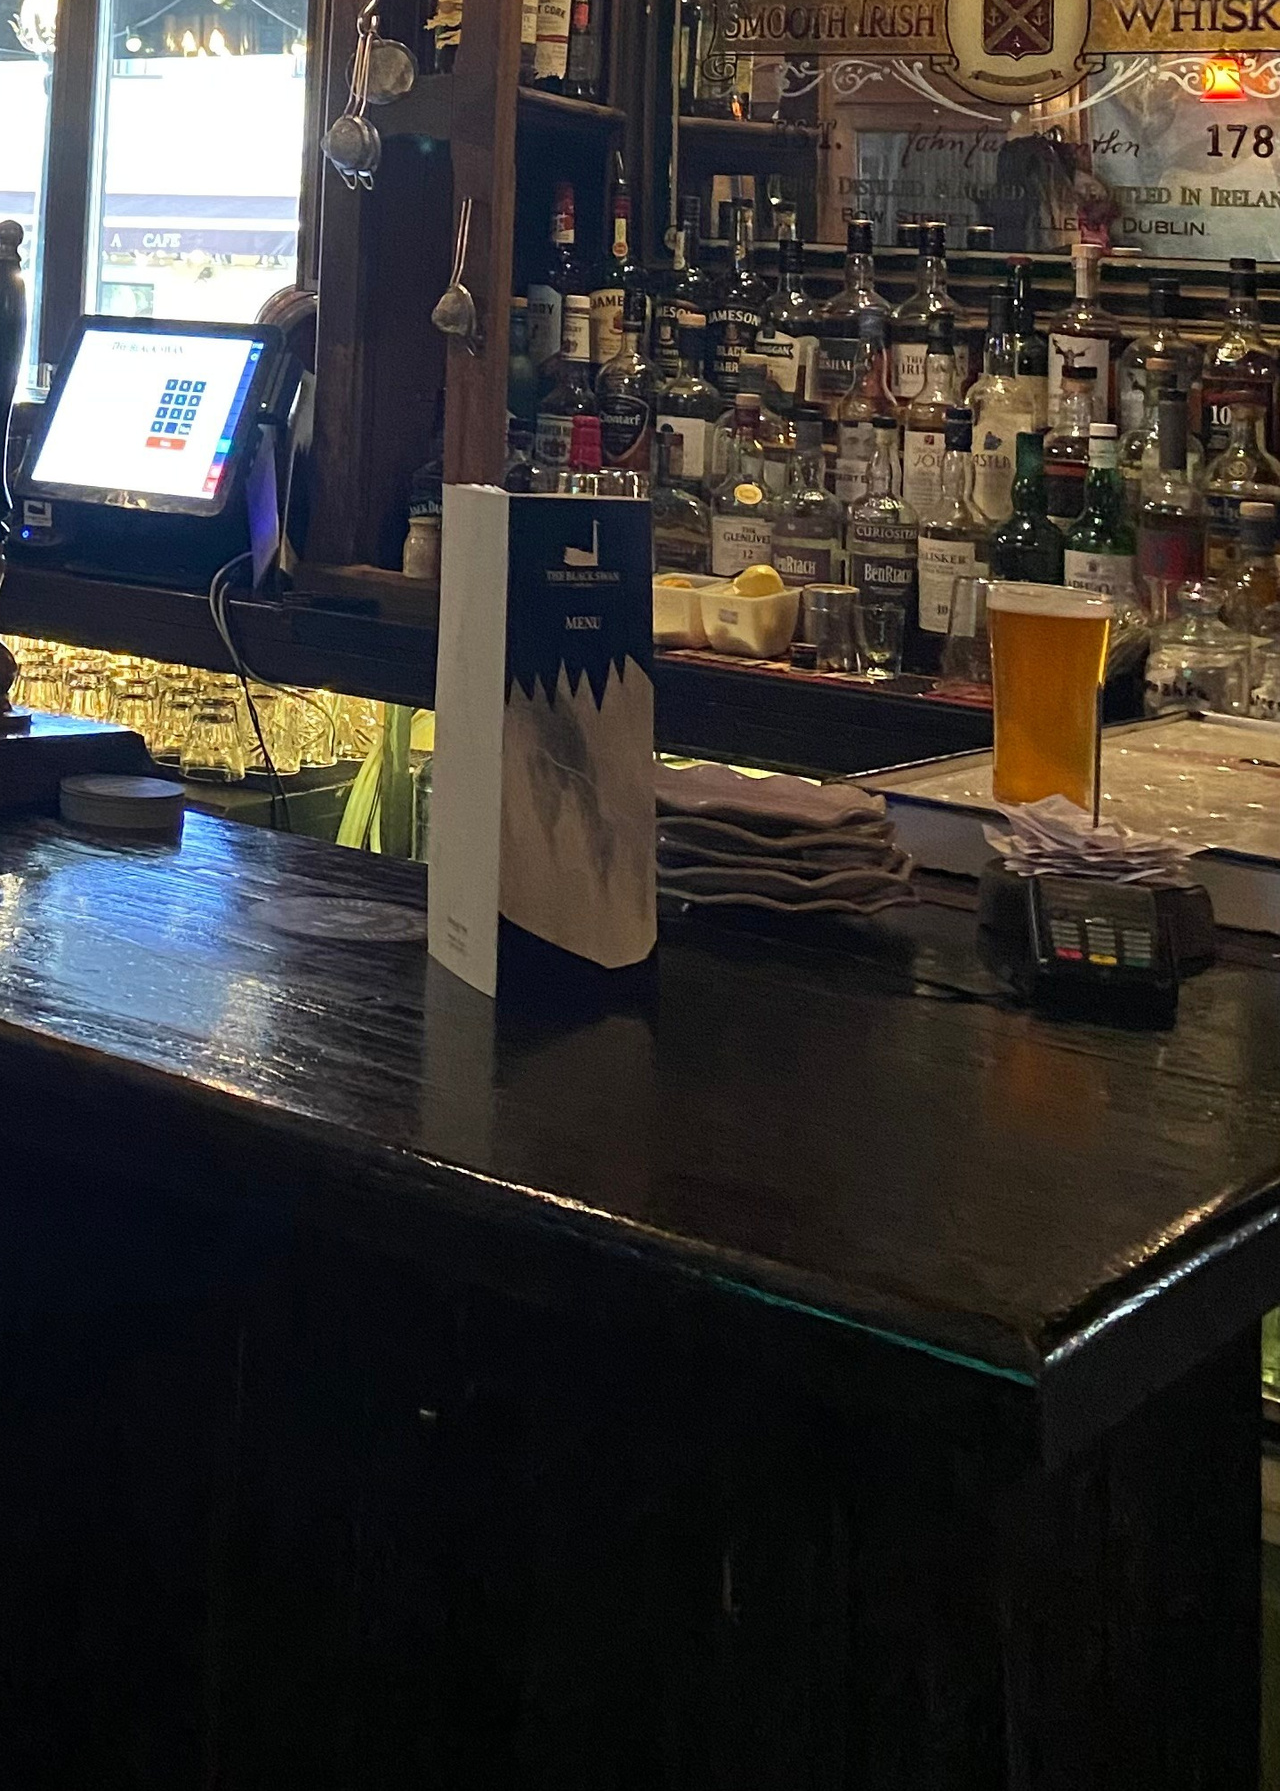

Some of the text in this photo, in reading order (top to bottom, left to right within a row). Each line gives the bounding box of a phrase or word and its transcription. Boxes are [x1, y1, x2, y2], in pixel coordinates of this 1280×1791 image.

[723, 1, 847, 39] SMOOTH
[857, 0, 937, 39] IRISH
[1180, 187, 1202, 206] IN
[708, 309, 762, 327] JAMESON
[1210, 405, 1232, 425] 10
[742, 549, 754, 559] 12
[546, 571, 620, 581] THE BLACK SWAN
[565, 616, 602, 630] MENU
